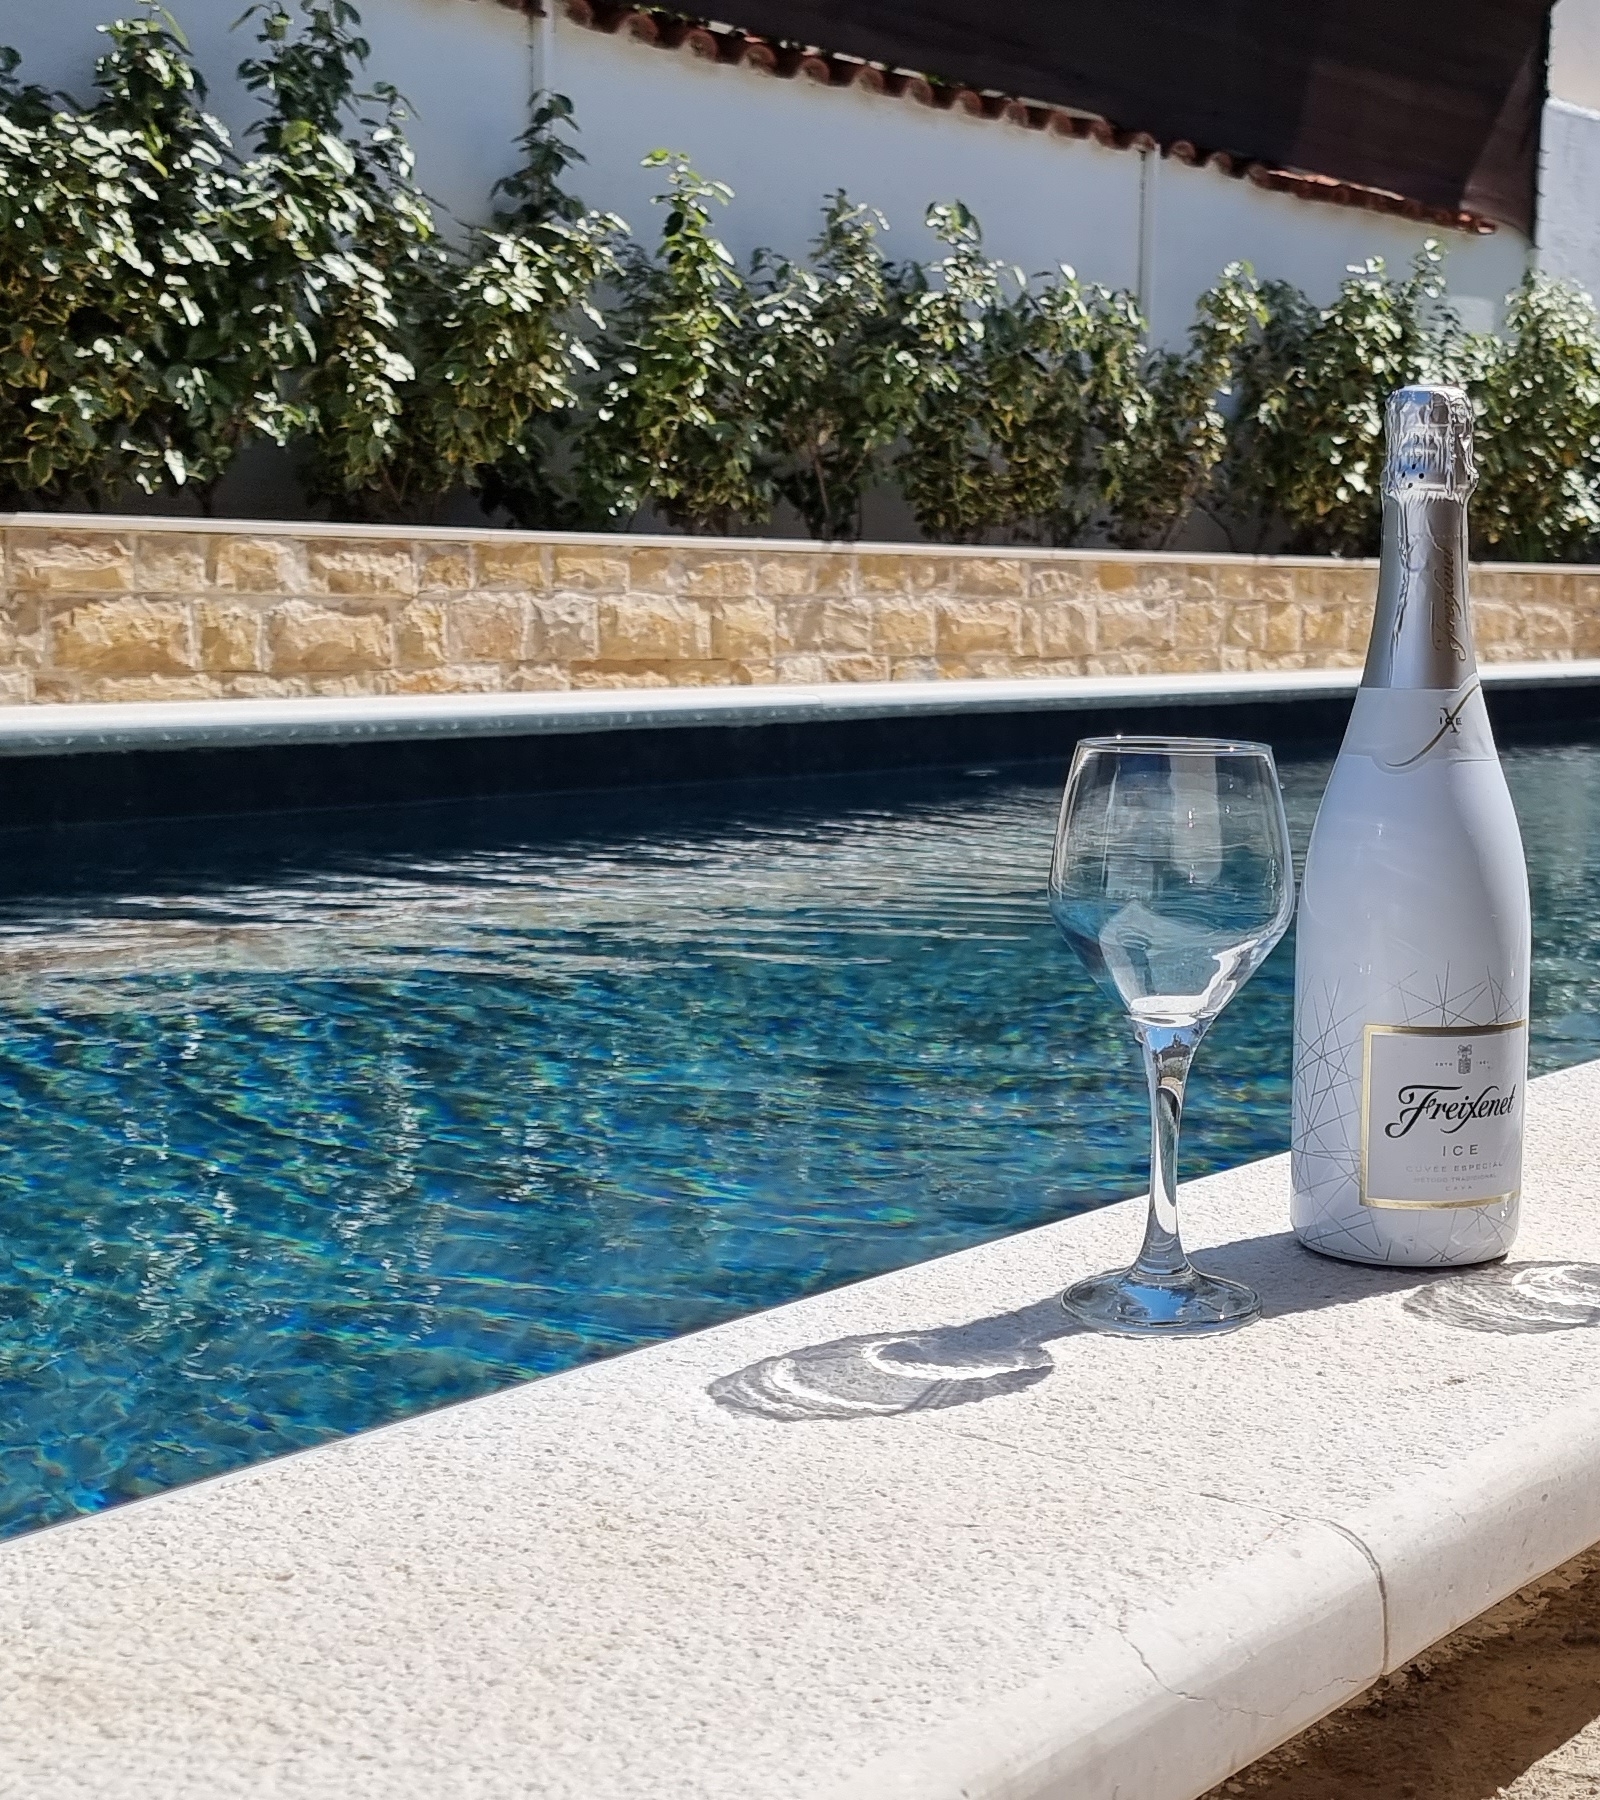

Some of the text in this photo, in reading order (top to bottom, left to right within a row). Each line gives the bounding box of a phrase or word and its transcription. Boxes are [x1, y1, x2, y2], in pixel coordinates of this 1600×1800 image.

[1439, 716, 1463, 726] ICE
[1384, 1083, 1517, 1139] Freixenet
[1442, 1144, 1479, 1157] ICE
[1454, 1161, 1503, 1172] ESPECIAL
